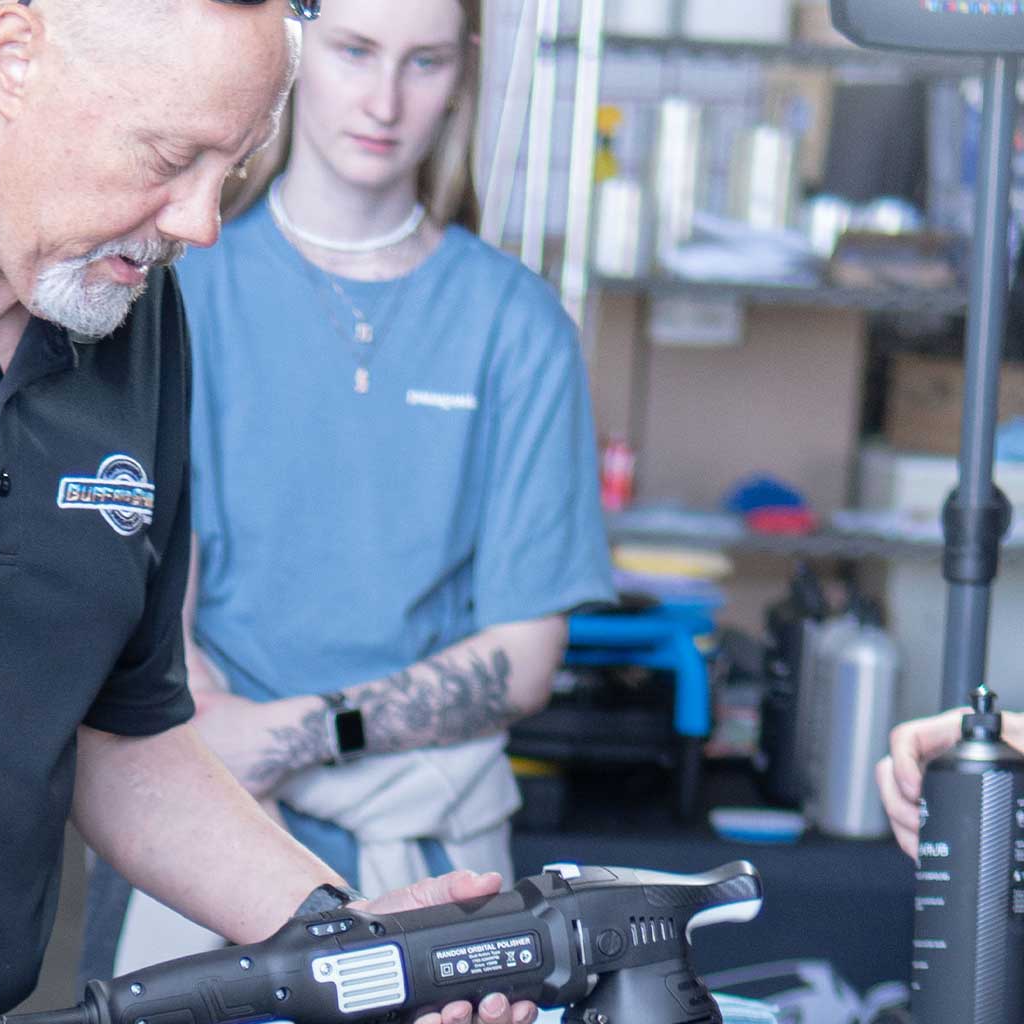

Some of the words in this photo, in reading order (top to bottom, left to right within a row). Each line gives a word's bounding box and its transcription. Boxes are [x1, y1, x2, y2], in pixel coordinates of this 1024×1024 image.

[326, 924, 334, 933] 4
[339, 922, 347, 931] 5
[436, 949, 467, 959] RANDOM
[467, 944, 497, 953] ORBITAL
[497, 937, 530, 948] POLISHER
